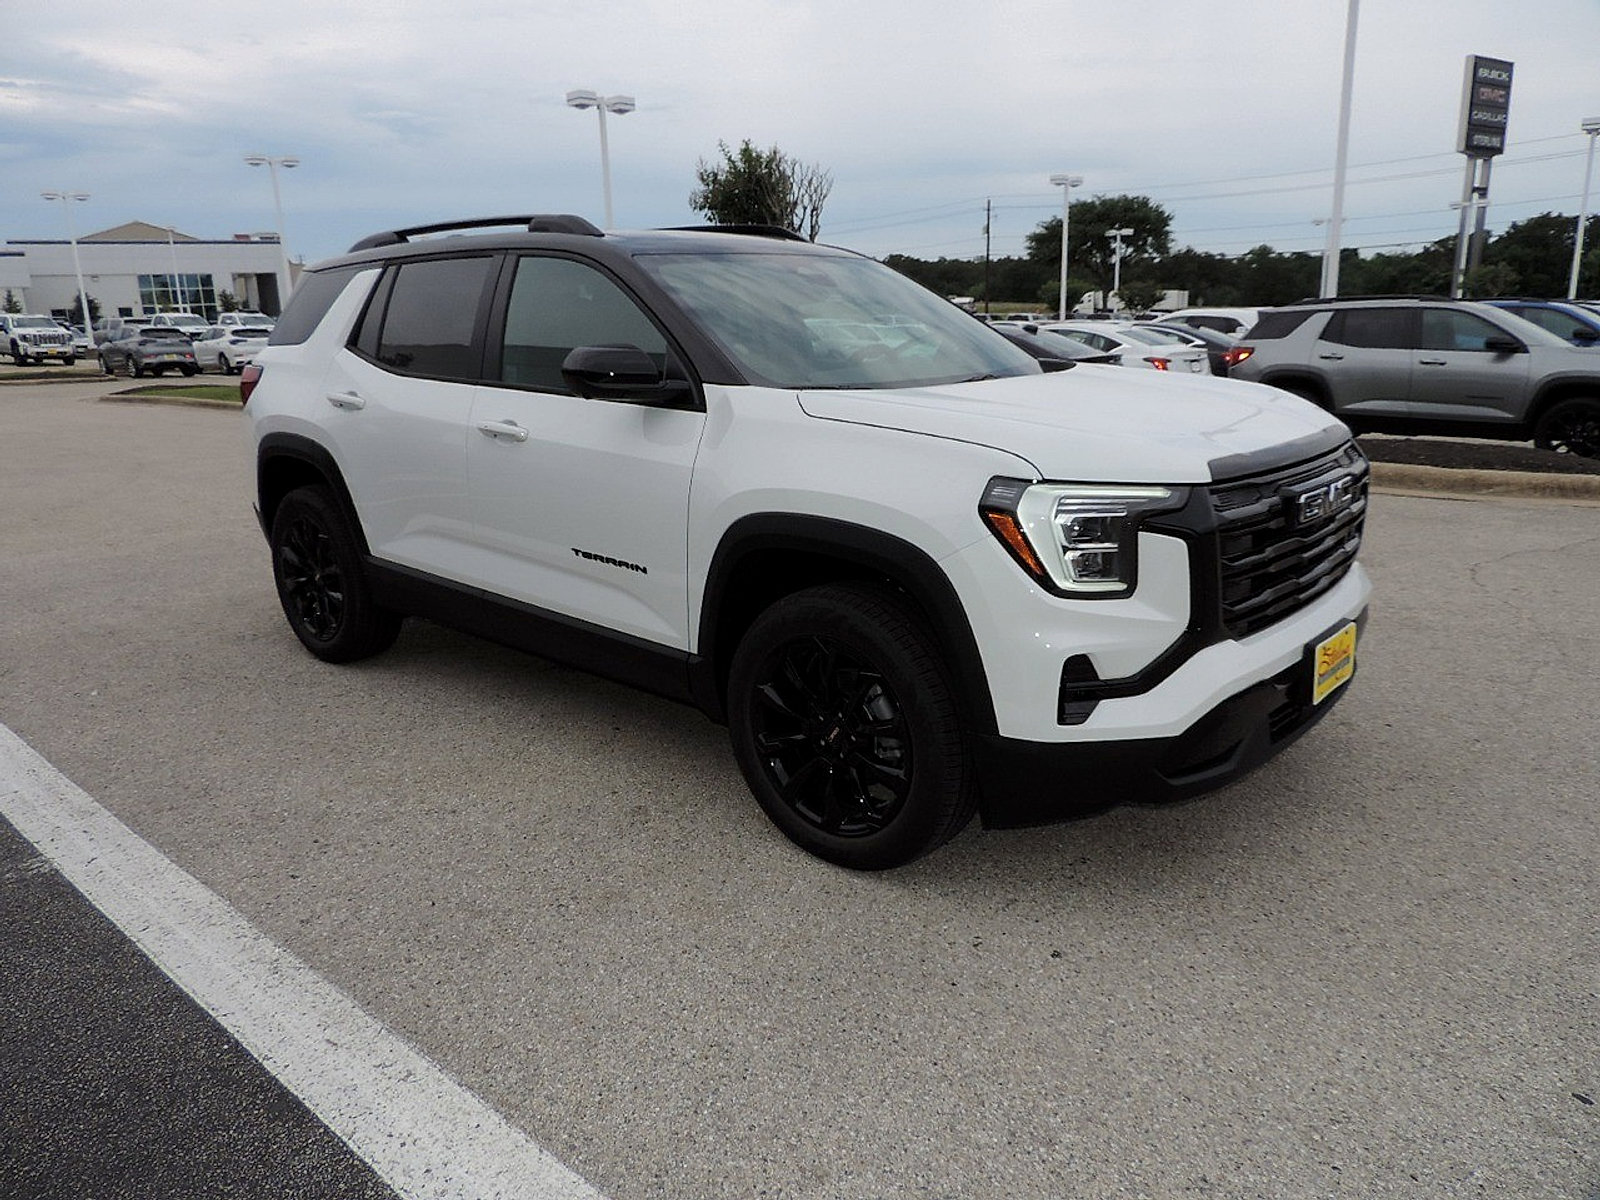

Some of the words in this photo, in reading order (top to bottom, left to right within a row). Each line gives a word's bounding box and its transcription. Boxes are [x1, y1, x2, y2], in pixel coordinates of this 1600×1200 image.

[1478, 67, 1510, 81] BUICK
[1480, 88, 1506, 102] GMC
[1298, 478, 1352, 523] GMC
[571, 548, 648, 574] TERRAIN
